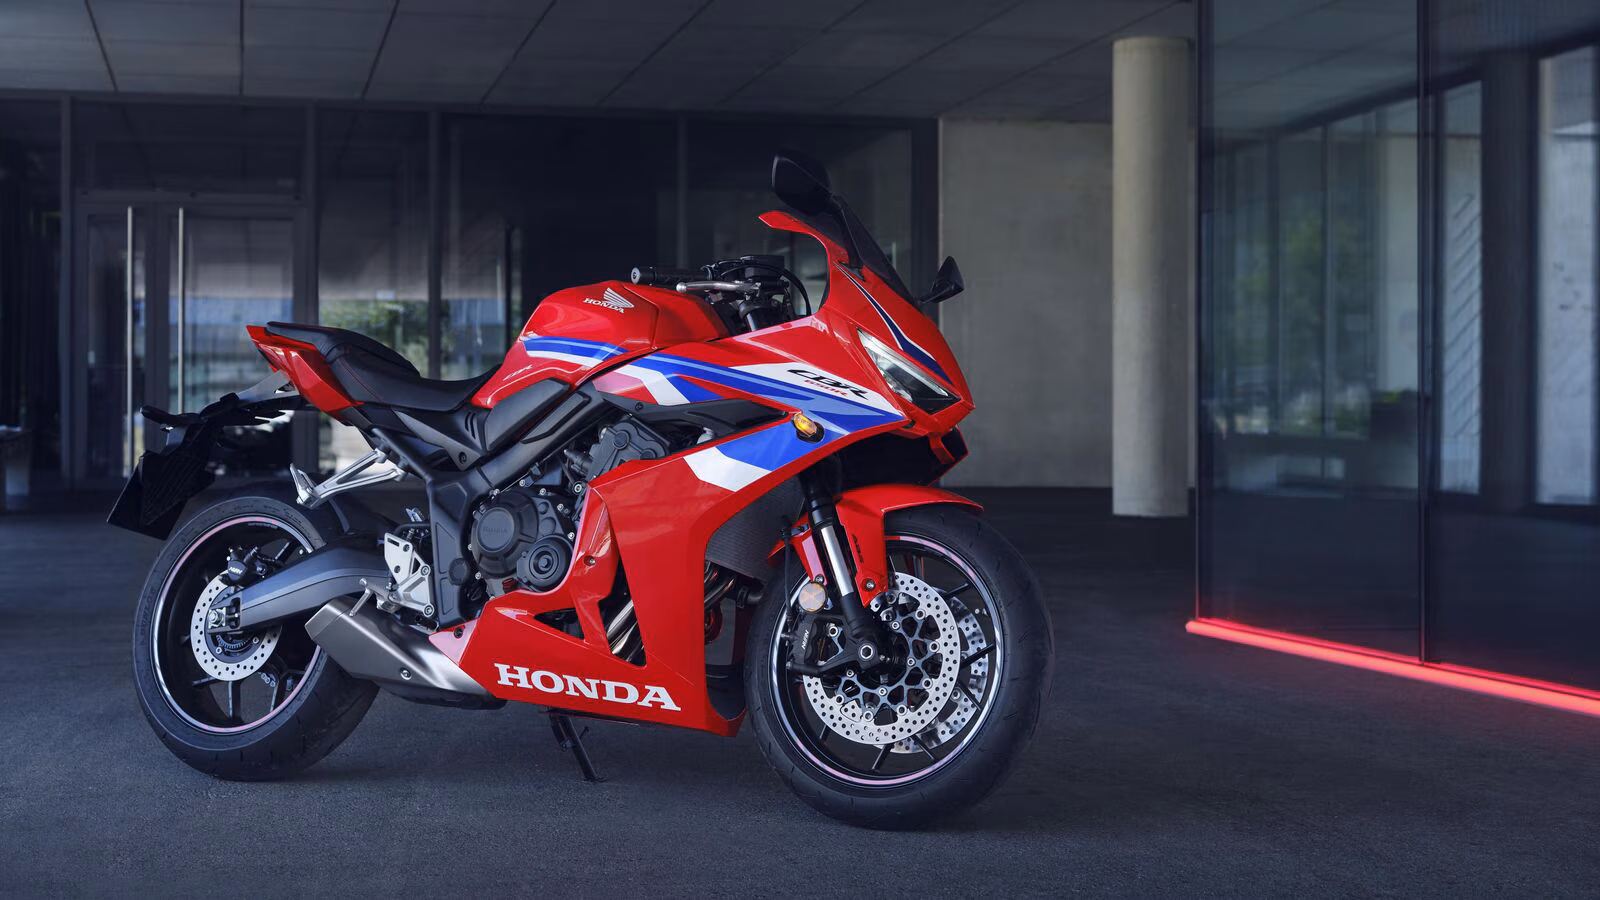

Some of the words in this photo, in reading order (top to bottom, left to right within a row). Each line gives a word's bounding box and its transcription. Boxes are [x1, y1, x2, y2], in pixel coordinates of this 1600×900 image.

[583, 297, 624, 314] HONDA
[787, 369, 869, 400] CBR
[494, 662, 682, 712] HONDA
